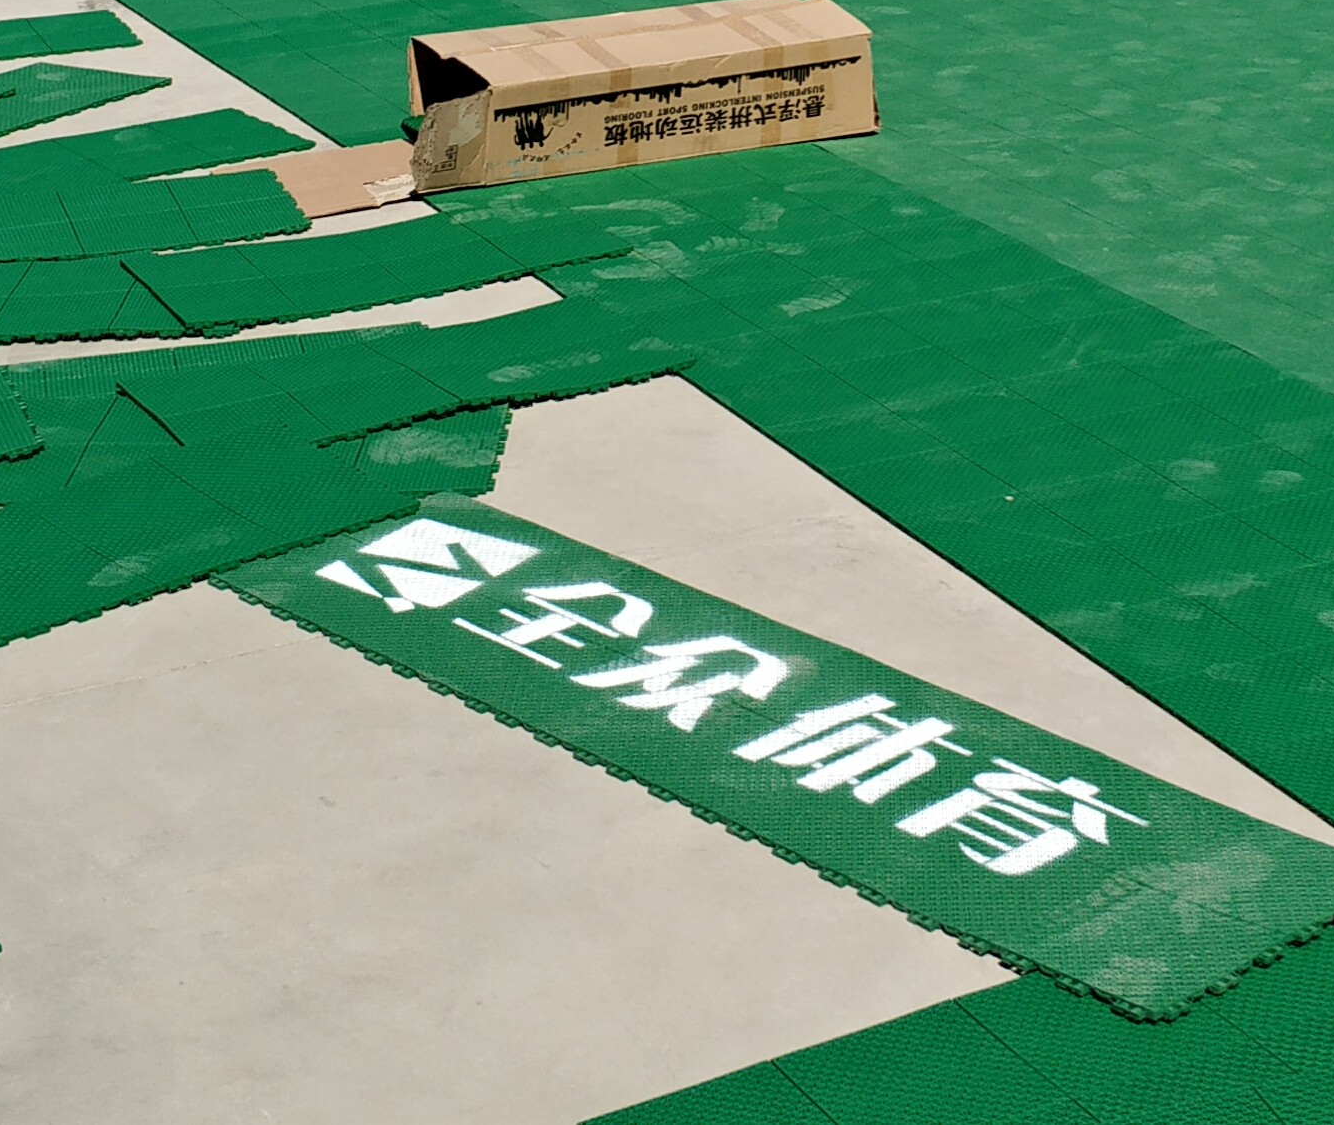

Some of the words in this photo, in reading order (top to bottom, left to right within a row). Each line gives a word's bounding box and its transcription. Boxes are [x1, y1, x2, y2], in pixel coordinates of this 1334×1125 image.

[767, 84, 825, 101] SUSPENSION
[658, 104, 688, 117] SPORT
[692, 94, 762, 111] INTERLOCKING
[604, 108, 653, 123] FLOORING
[604, 95, 826, 147] 悬浮式拼装运动地板
[453, 580, 1150, 876] 全众体育
